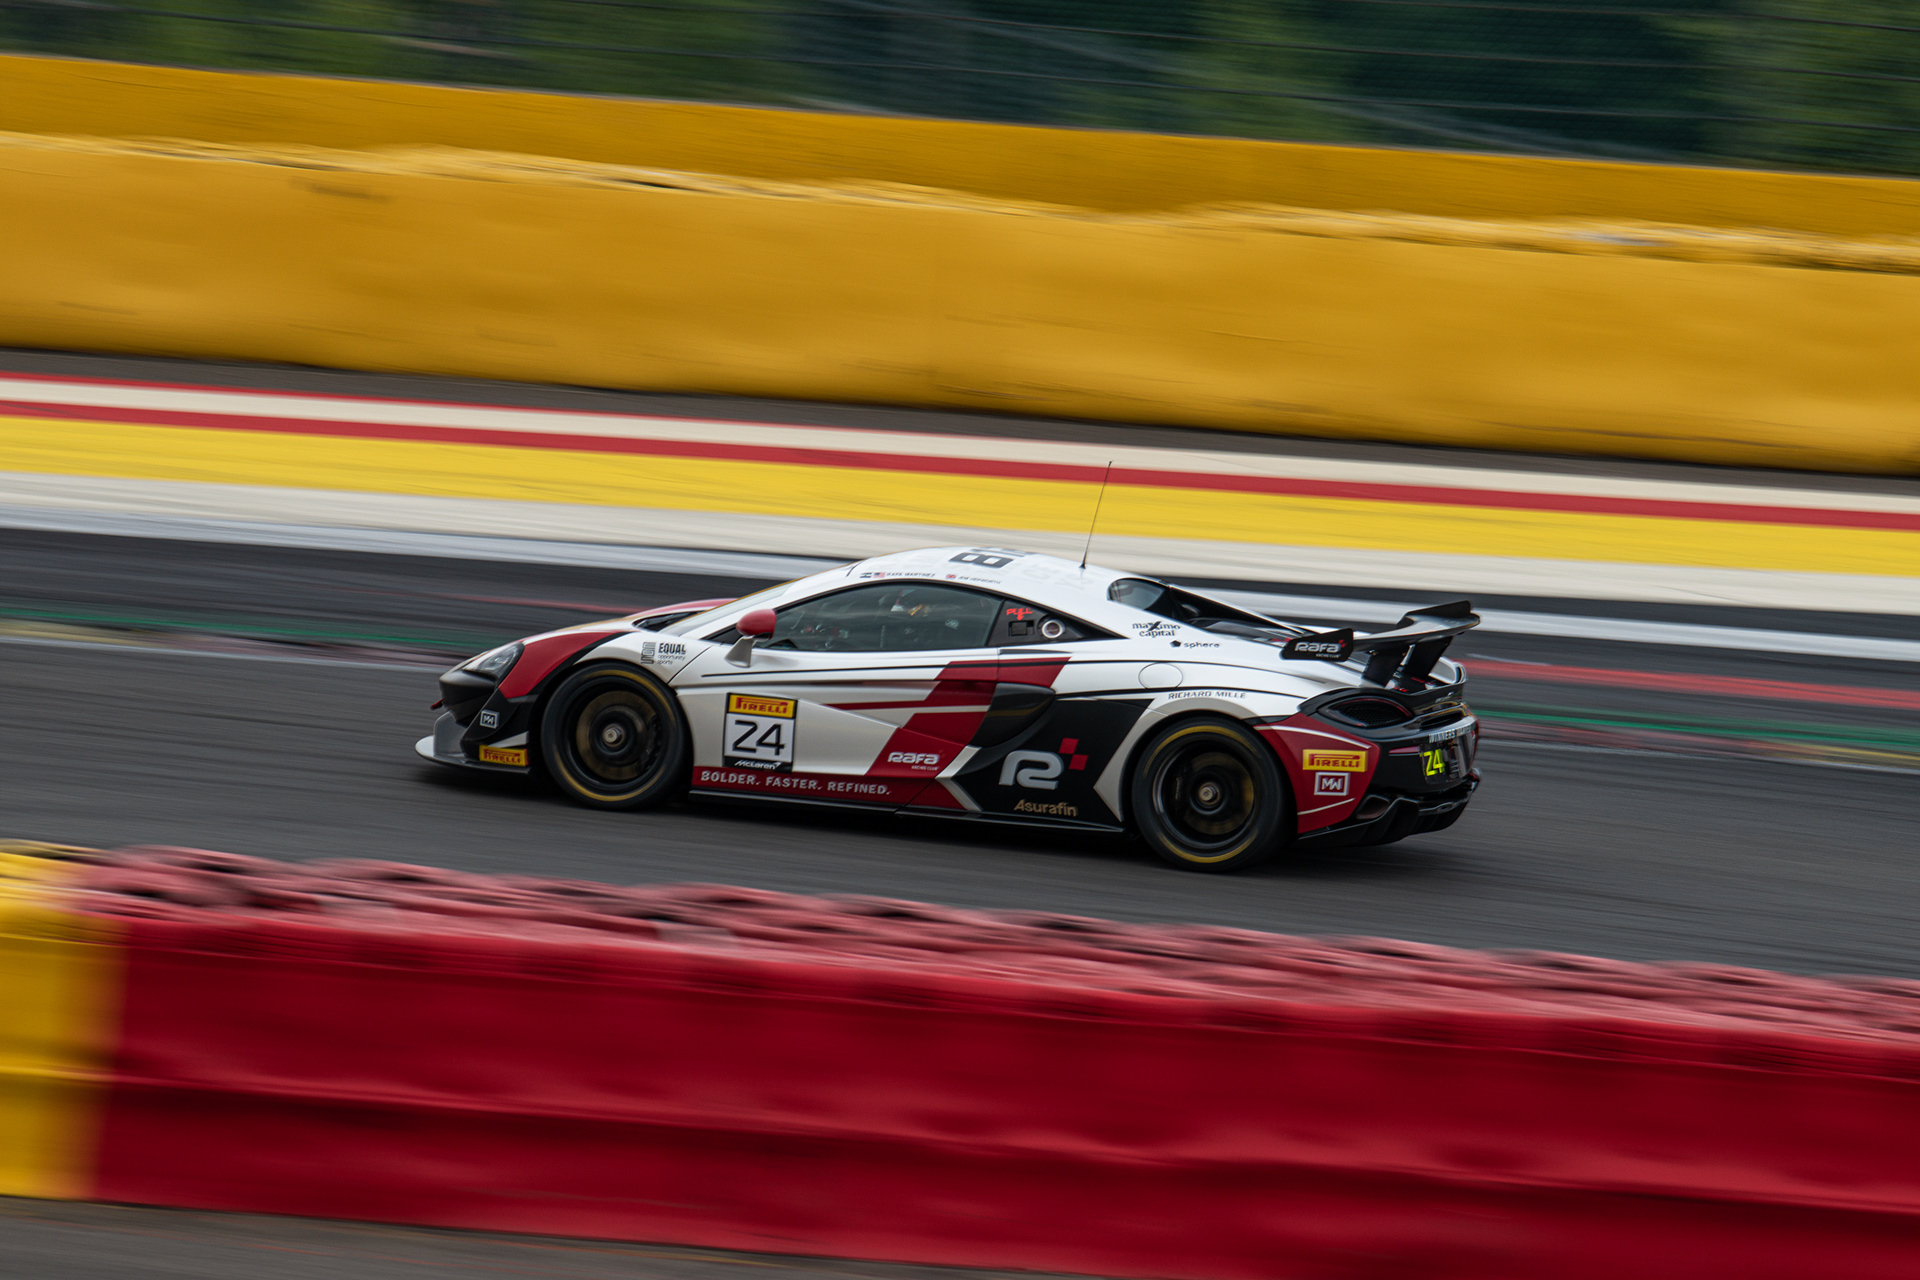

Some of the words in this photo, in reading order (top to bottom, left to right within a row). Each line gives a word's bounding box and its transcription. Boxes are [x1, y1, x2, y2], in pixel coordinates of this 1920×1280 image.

[1006, 607, 1034, 616] PULL
[1139, 629, 1176, 639] capital
[658, 642, 687, 655] EQUAL
[1184, 641, 1221, 650] sphere
[1168, 690, 1212, 700] RICHARD
[1215, 691, 1247, 700] MILLE
[735, 697, 789, 714] PIRELLI
[732, 719, 785, 756] 24
[483, 748, 521, 764] PIRELLI
[1308, 753, 1360, 768] PIRELLI
[1421, 749, 1446, 776] 24
[734, 759, 784, 770] McLaren
[700, 770, 761, 786] BOLDER.
[765, 775, 822, 791] FASTER.
[827, 780, 892, 796] REFINED.
[1014, 799, 1078, 817] Asurafin
